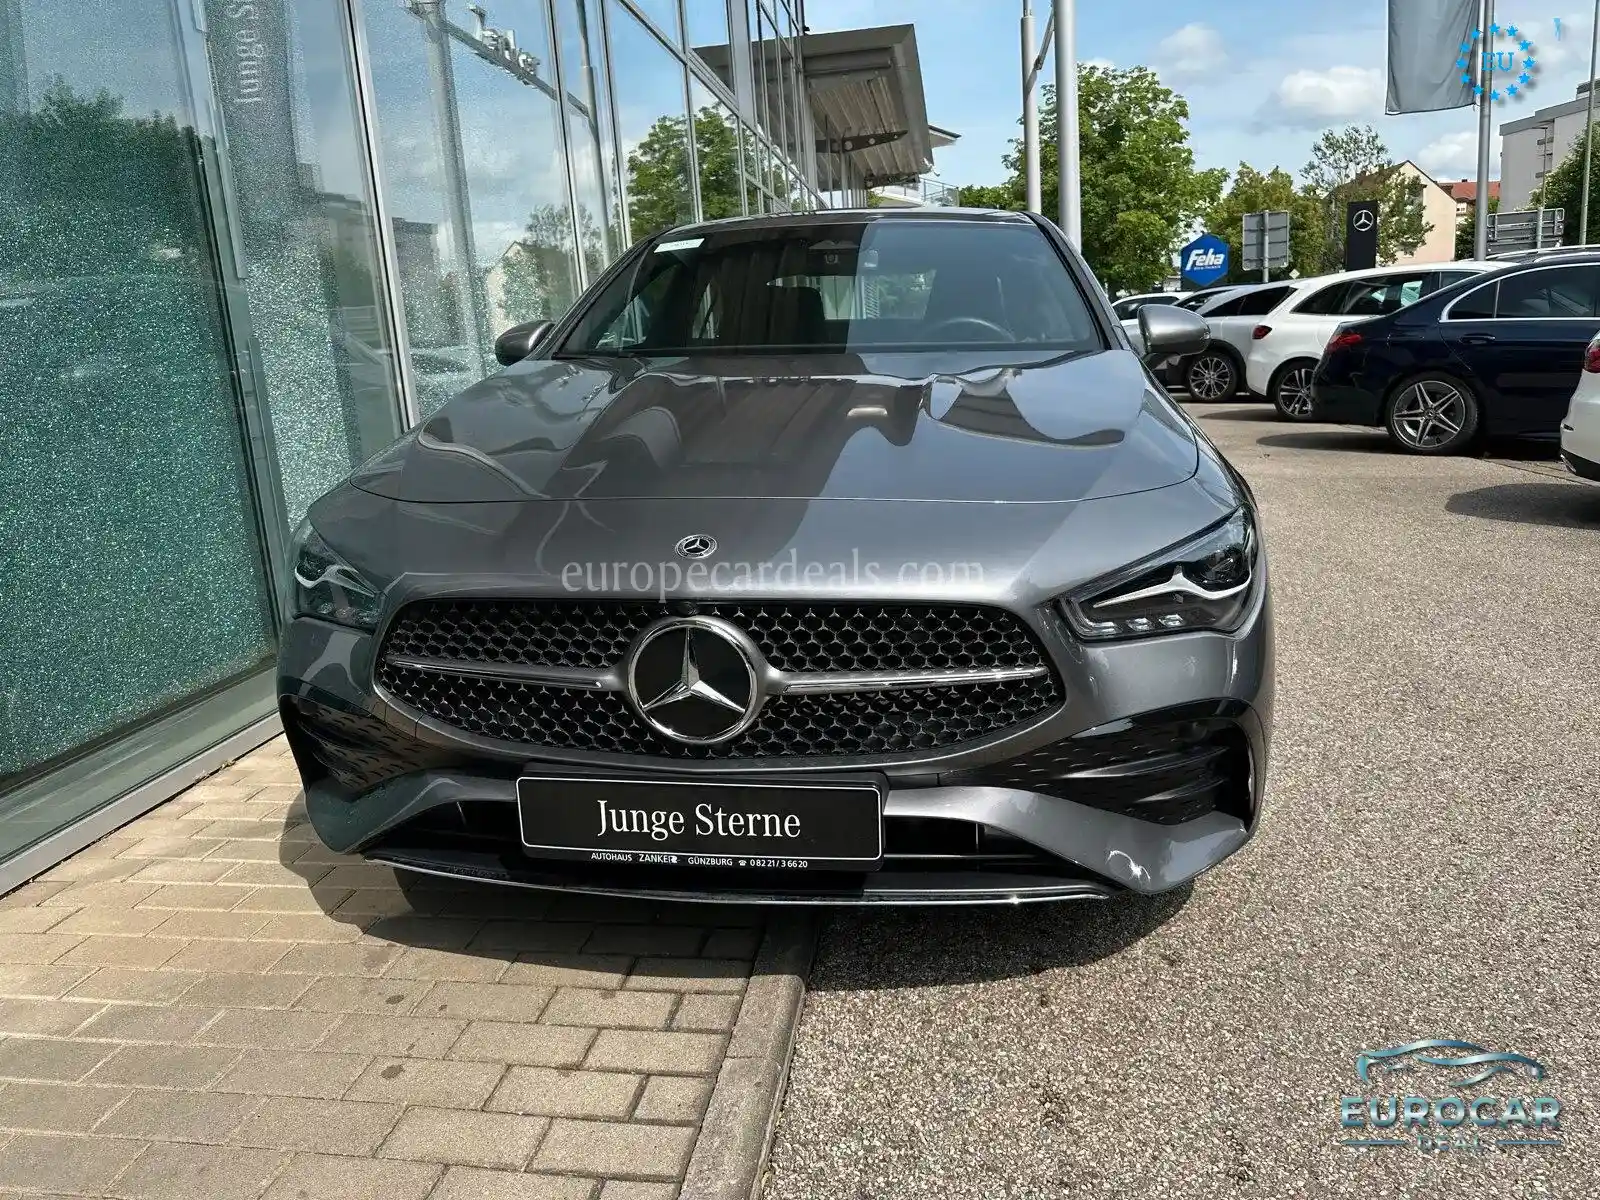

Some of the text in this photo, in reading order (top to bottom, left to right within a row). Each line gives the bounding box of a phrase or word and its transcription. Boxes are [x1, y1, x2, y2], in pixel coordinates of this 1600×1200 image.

[234, 29, 264, 103] Junge
[1185, 248, 1225, 271] Feha
[597, 800, 801, 841] Junge Sterne
[591, 852, 633, 863] AUTOHAUS
[687, 856, 733, 867] GÜNZBURG
